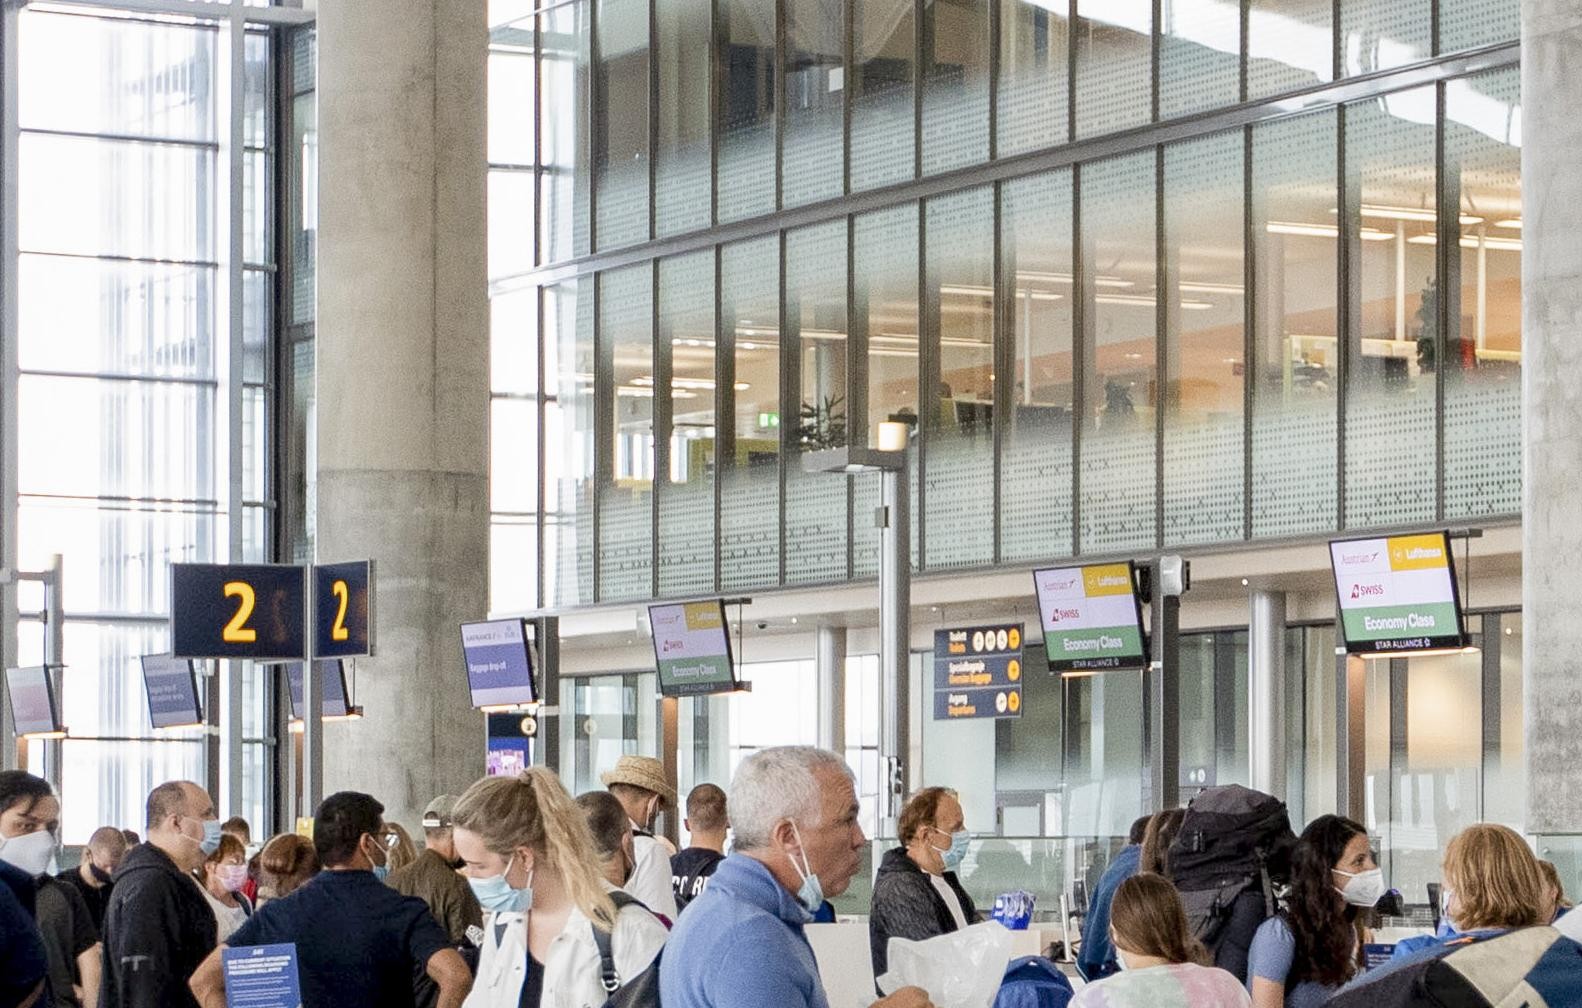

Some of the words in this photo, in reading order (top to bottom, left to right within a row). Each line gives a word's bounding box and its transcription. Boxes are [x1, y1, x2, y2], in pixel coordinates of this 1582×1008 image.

[1360, 584, 1384, 596] SWISS
[223, 581, 256, 642] 2
[332, 580, 349, 641] 2
[1059, 608, 1080, 620] SWISS
[1364, 616, 1408, 632] Economy
[1408, 613, 1435, 628] Class
[1064, 636, 1100, 652] Economy
[1100, 635, 1122, 648] Class
[1376, 640, 1392, 650] STAR
[1392, 638, 1424, 648] ALLIANCE
[1072, 660, 1086, 669] STAR
[1088, 658, 1114, 668] ALLIANCE
